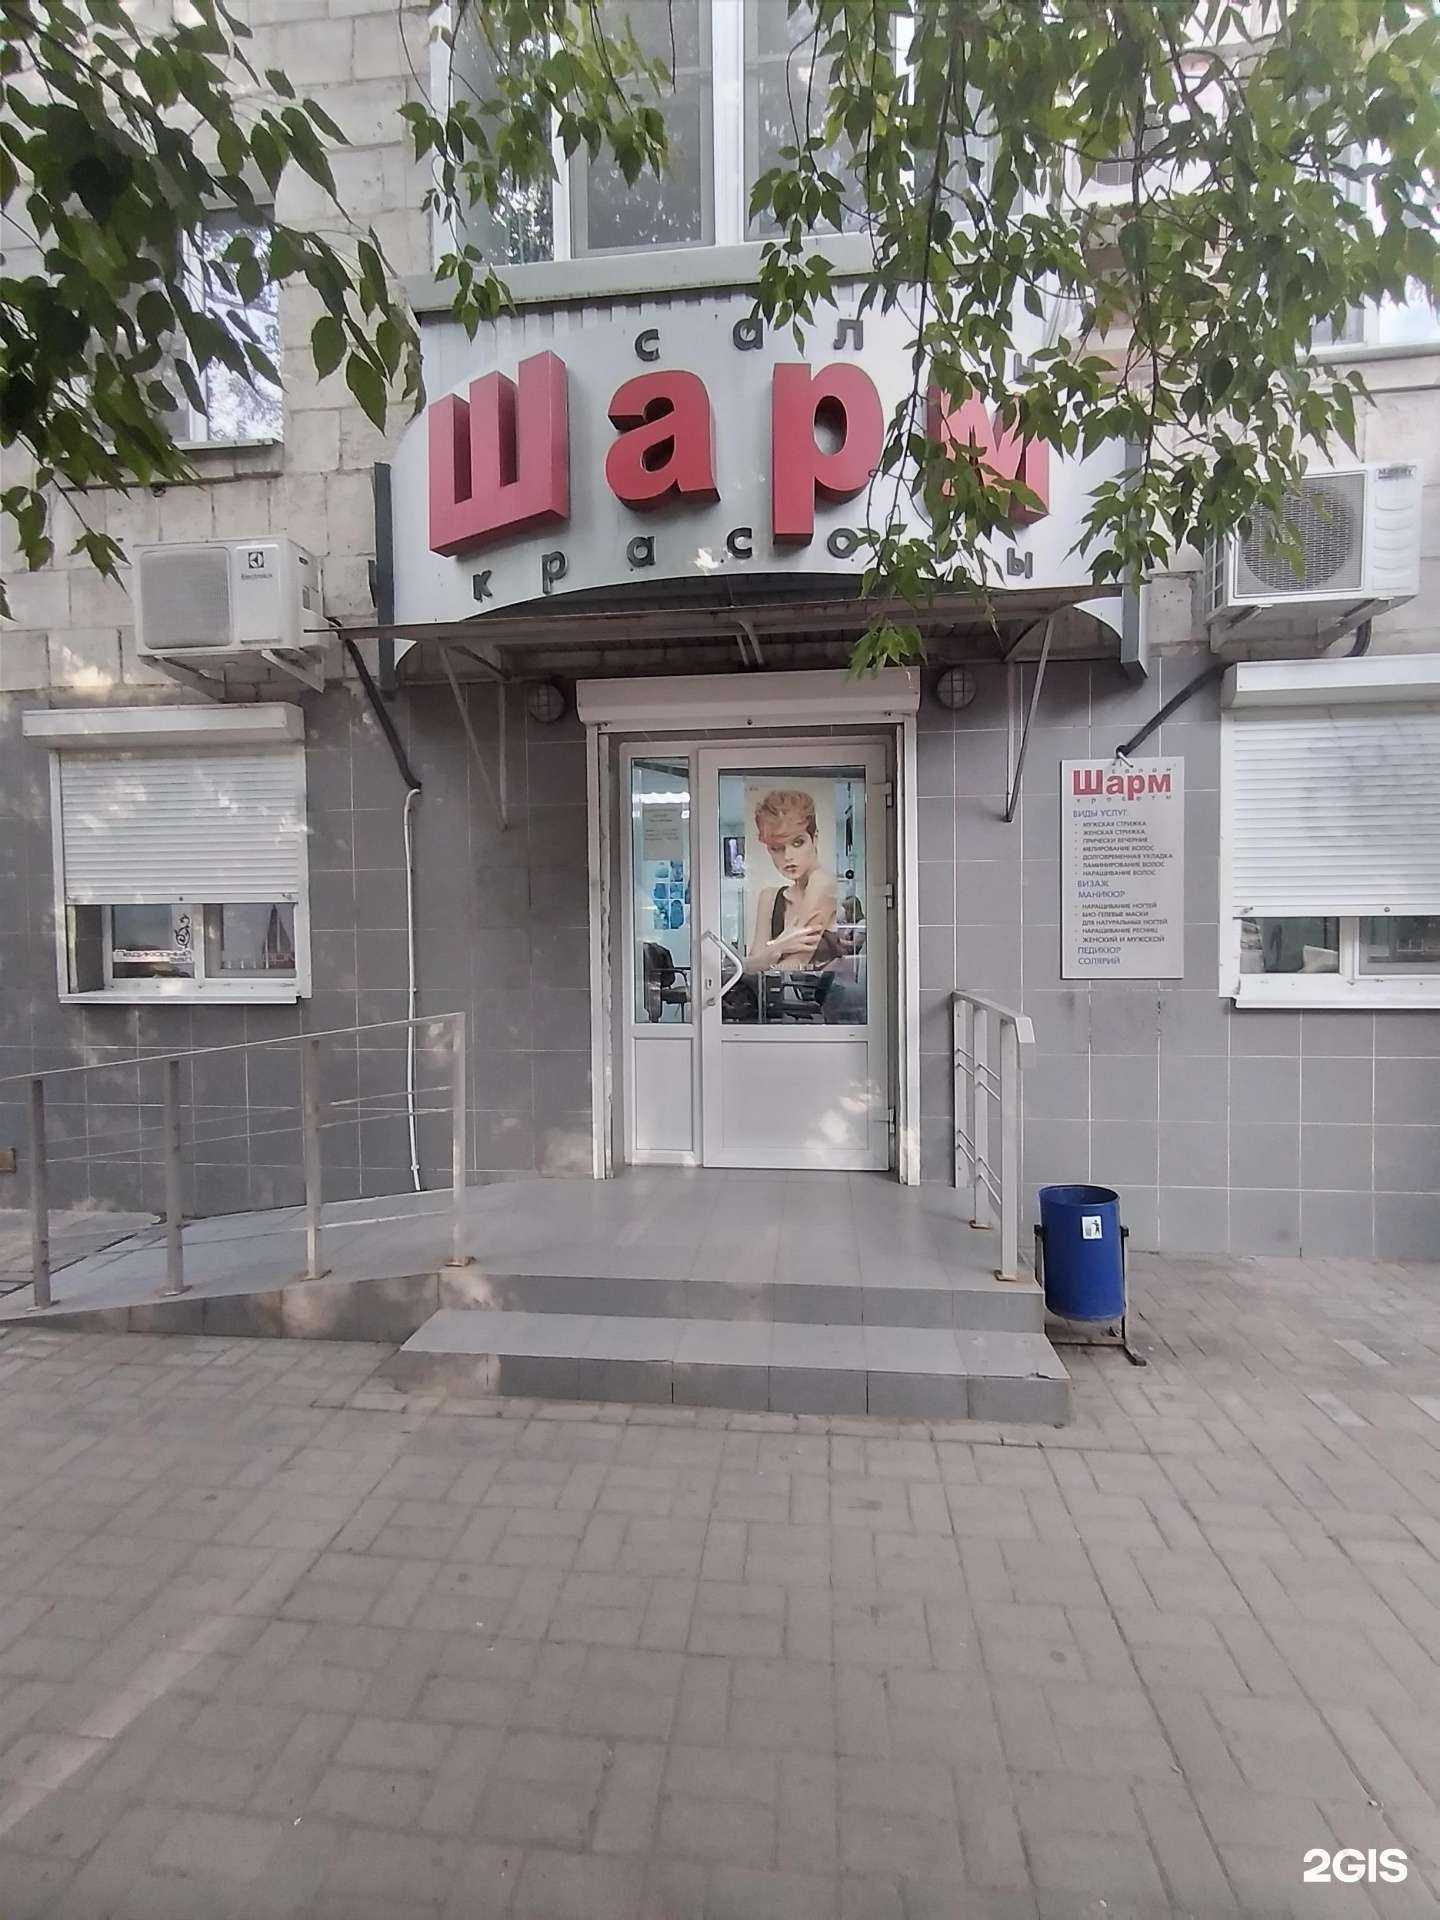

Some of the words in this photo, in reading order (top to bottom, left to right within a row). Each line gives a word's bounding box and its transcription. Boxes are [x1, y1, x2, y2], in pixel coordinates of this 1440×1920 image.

[635, 316, 1036, 381] салн
[429, 350, 1051, 557] Шарм
[1073, 769, 1171, 801] Шарм
[1073, 810, 1098, 818] ВИДЫ
[1101, 809, 1127, 817] УСЛУГ
[1078, 880, 1109, 888] ВИЗАЖ
[1078, 890, 1126, 898] МАНИКЮР
[1078, 957, 1120, 965] СОЛЯРИЙ
